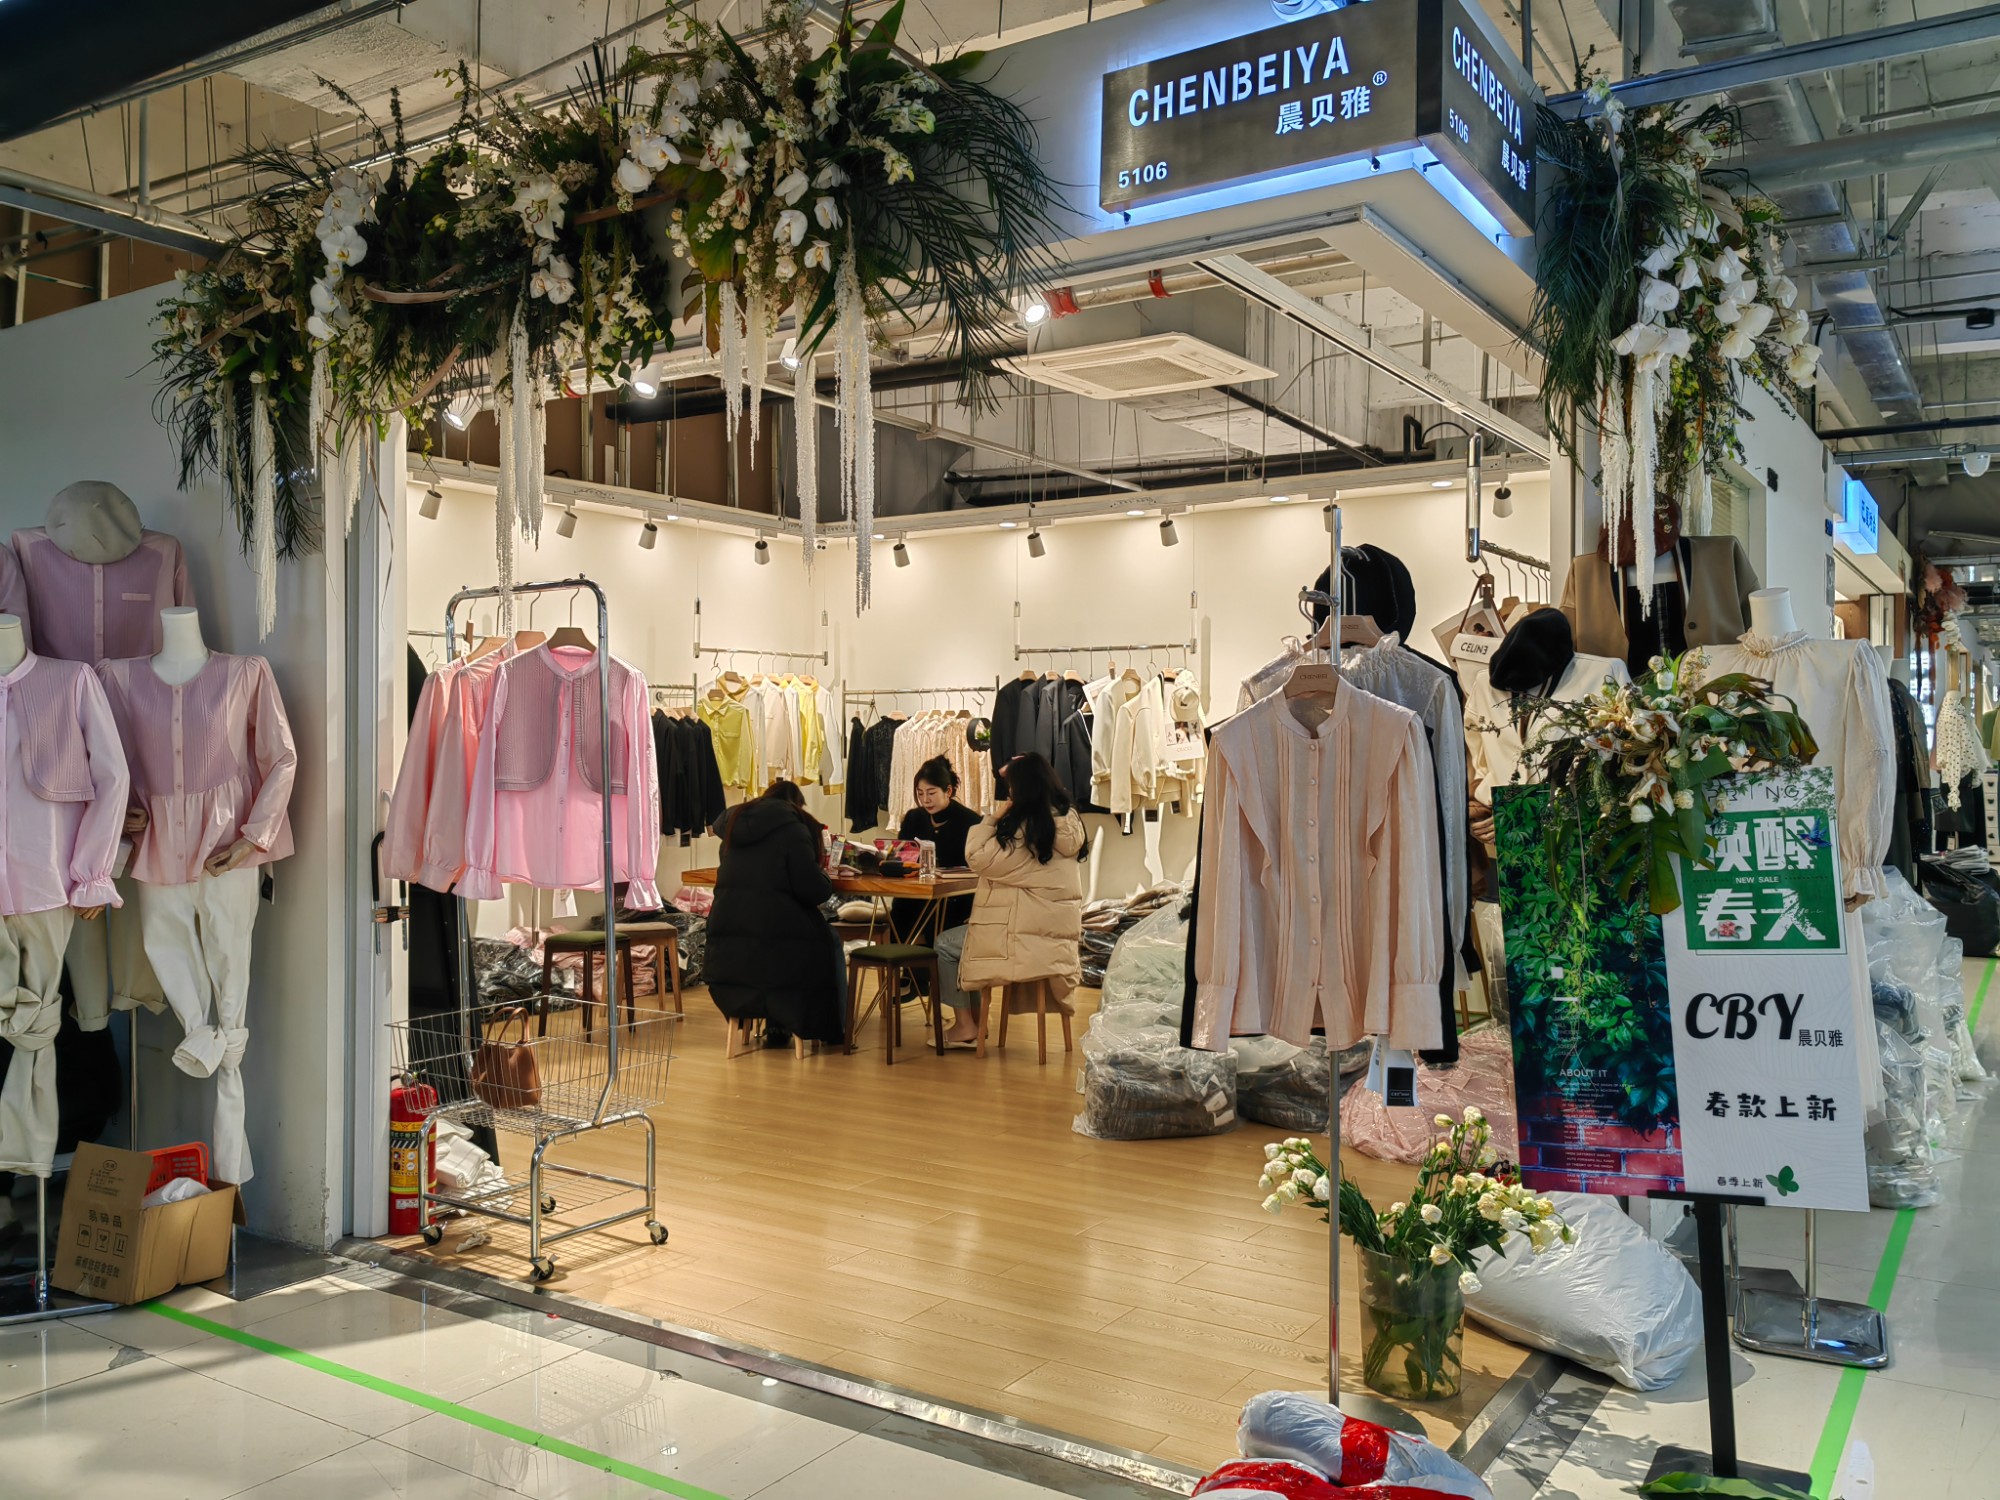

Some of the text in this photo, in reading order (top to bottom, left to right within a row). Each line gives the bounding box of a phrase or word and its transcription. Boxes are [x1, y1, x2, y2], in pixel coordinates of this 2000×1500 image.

[1128, 35, 1350, 127] CHENBEIYA
[1452, 26, 1522, 145] CHENBEIYA
[1275, 85, 1371, 135] 晨贝雅
[1449, 107, 1469, 144] 5106
[1118, 161, 1168, 189] 5106
[1735, 876, 1755, 884] NEW
[1696, 888, 1826, 942] 春天
[1685, 993, 1804, 1041] CBY
[1798, 1029, 1844, 1048] 晨贝雅
[1559, 1068, 1608, 1078] ABOUT IT
[1705, 1091, 1837, 1122] 春款上新
[1717, 1176, 1764, 1189] 春季上新
